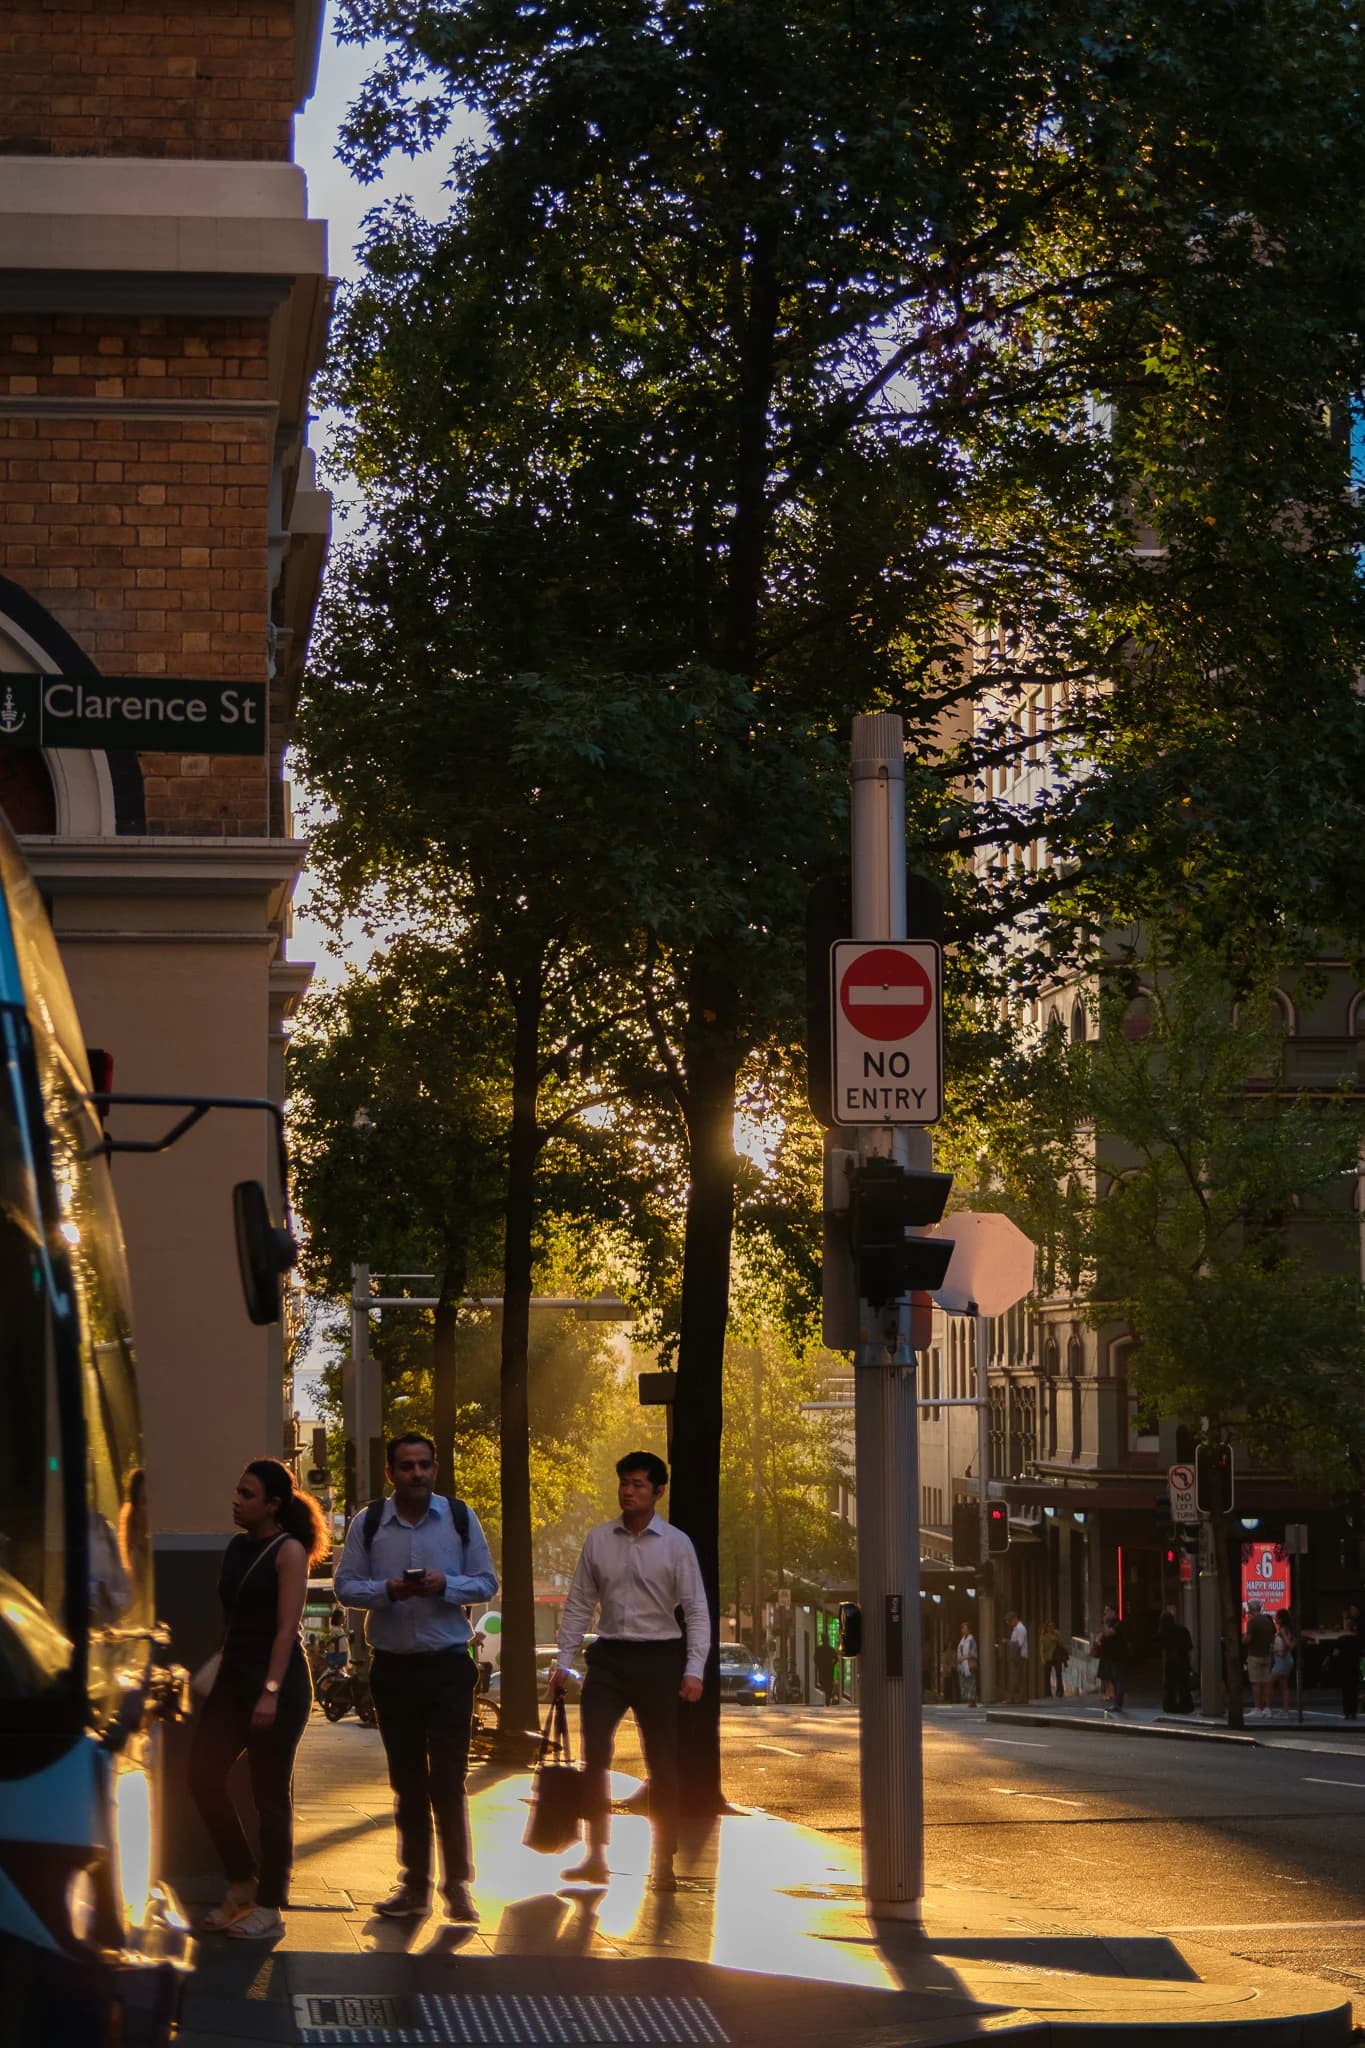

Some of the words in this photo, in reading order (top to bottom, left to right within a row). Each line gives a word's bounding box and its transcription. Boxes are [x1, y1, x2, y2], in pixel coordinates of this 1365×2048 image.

[44, 683, 208, 723] Clarence
[219, 689, 257, 725] St
[863, 1051, 910, 1078] NO
[847, 1088, 927, 1109] ENTRY
[1176, 1492, 1192, 1502] NO
[1176, 1511, 1195, 1519] TURN
[1246, 1580, 1266, 1590] HAPPY
[1267, 1580, 1285, 1590] HOUR
